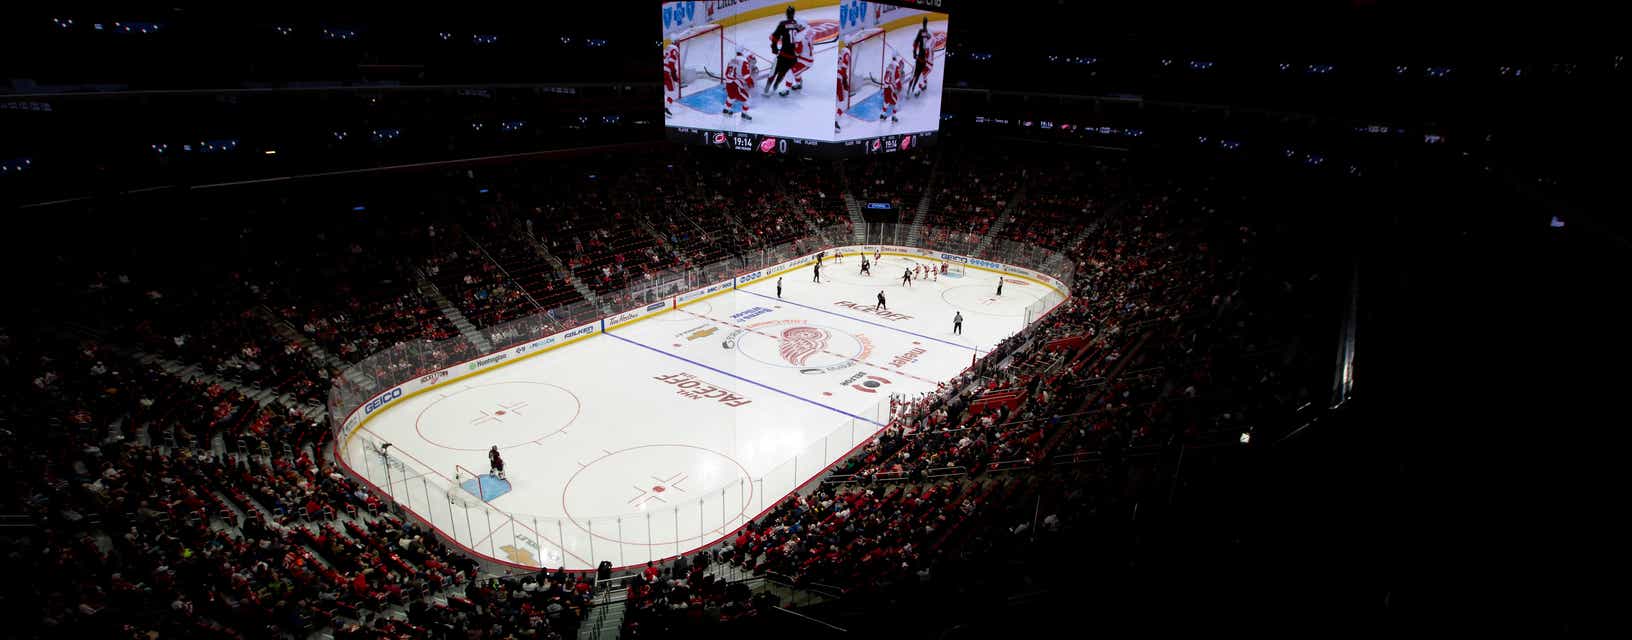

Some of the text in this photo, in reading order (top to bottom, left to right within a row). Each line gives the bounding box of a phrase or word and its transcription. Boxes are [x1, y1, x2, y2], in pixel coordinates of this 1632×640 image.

[704, 132, 709, 144] 1
[734, 137, 752, 147] 19:14
[780, 139, 788, 153] 0
[941, 253, 967, 263] GEICO
[564, 325, 594, 340] FALKEN
[364, 387, 402, 414] GEICO
[677, 389, 702, 400] NHL
